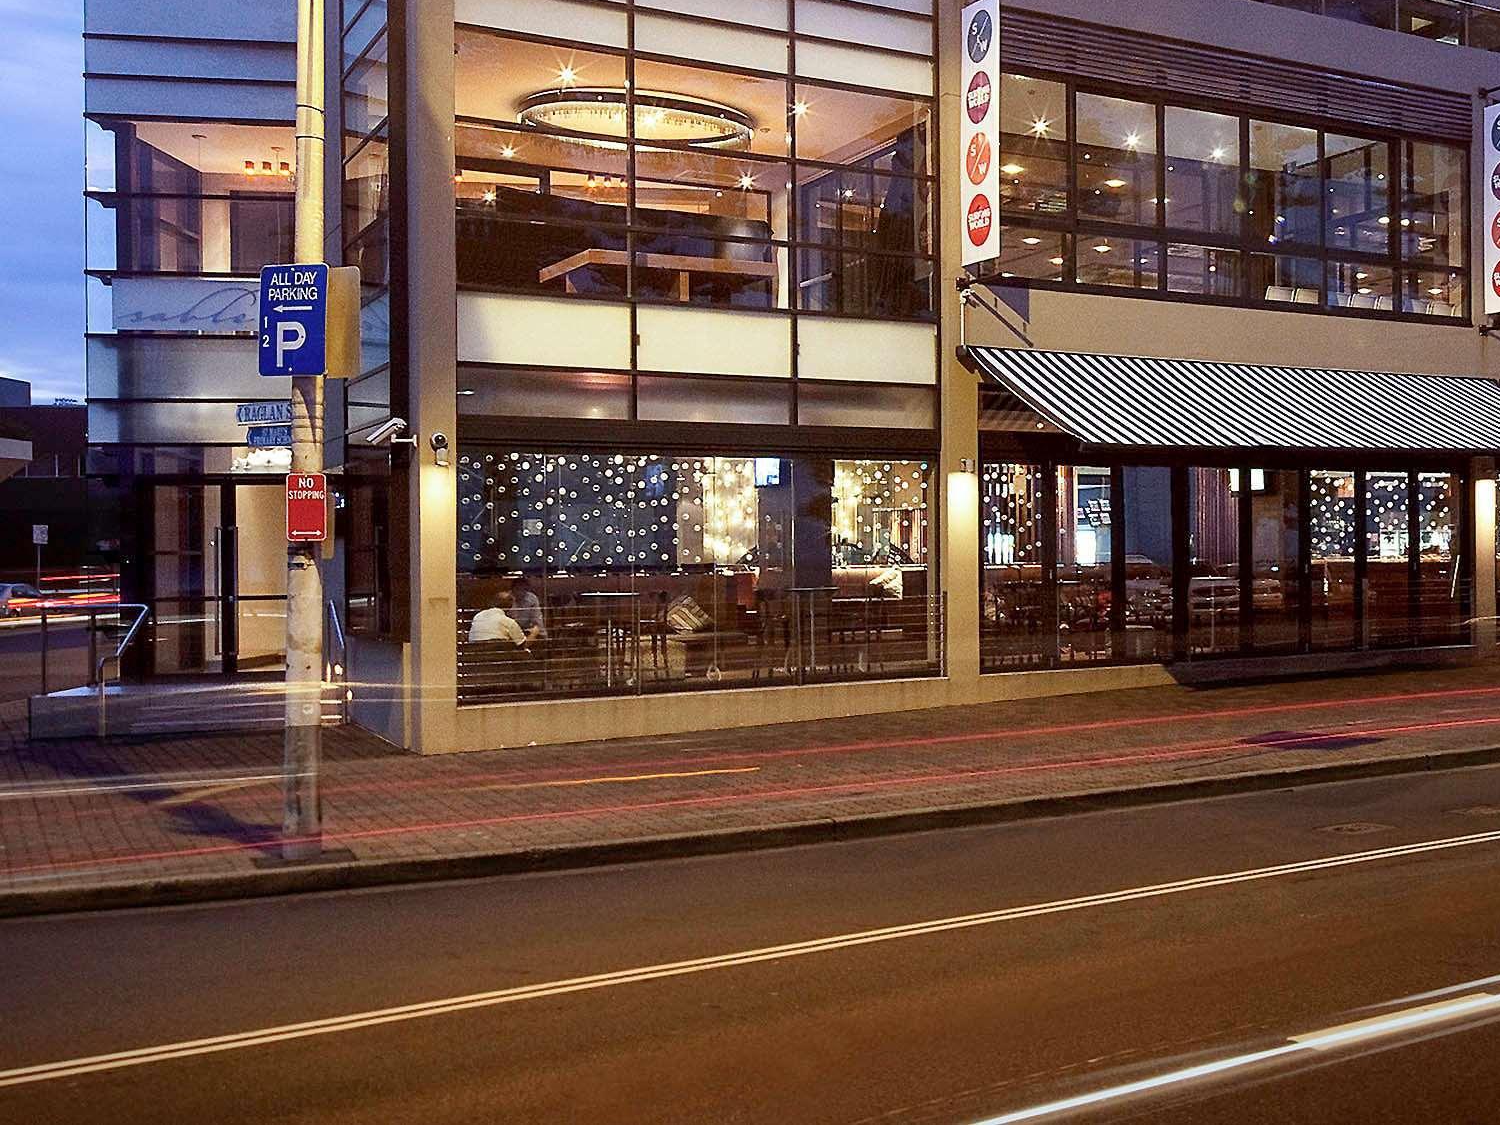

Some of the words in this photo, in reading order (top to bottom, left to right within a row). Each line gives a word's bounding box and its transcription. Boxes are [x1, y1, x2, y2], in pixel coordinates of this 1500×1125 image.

[270, 272, 292, 286] ALL
[294, 271, 318, 285] DAY
[268, 286, 318, 301] PARKING
[262, 334, 270, 348] 2
[276, 321, 306, 368] P
[298, 477, 314, 489] NO
[288, 490, 325, 500] STOPPING
